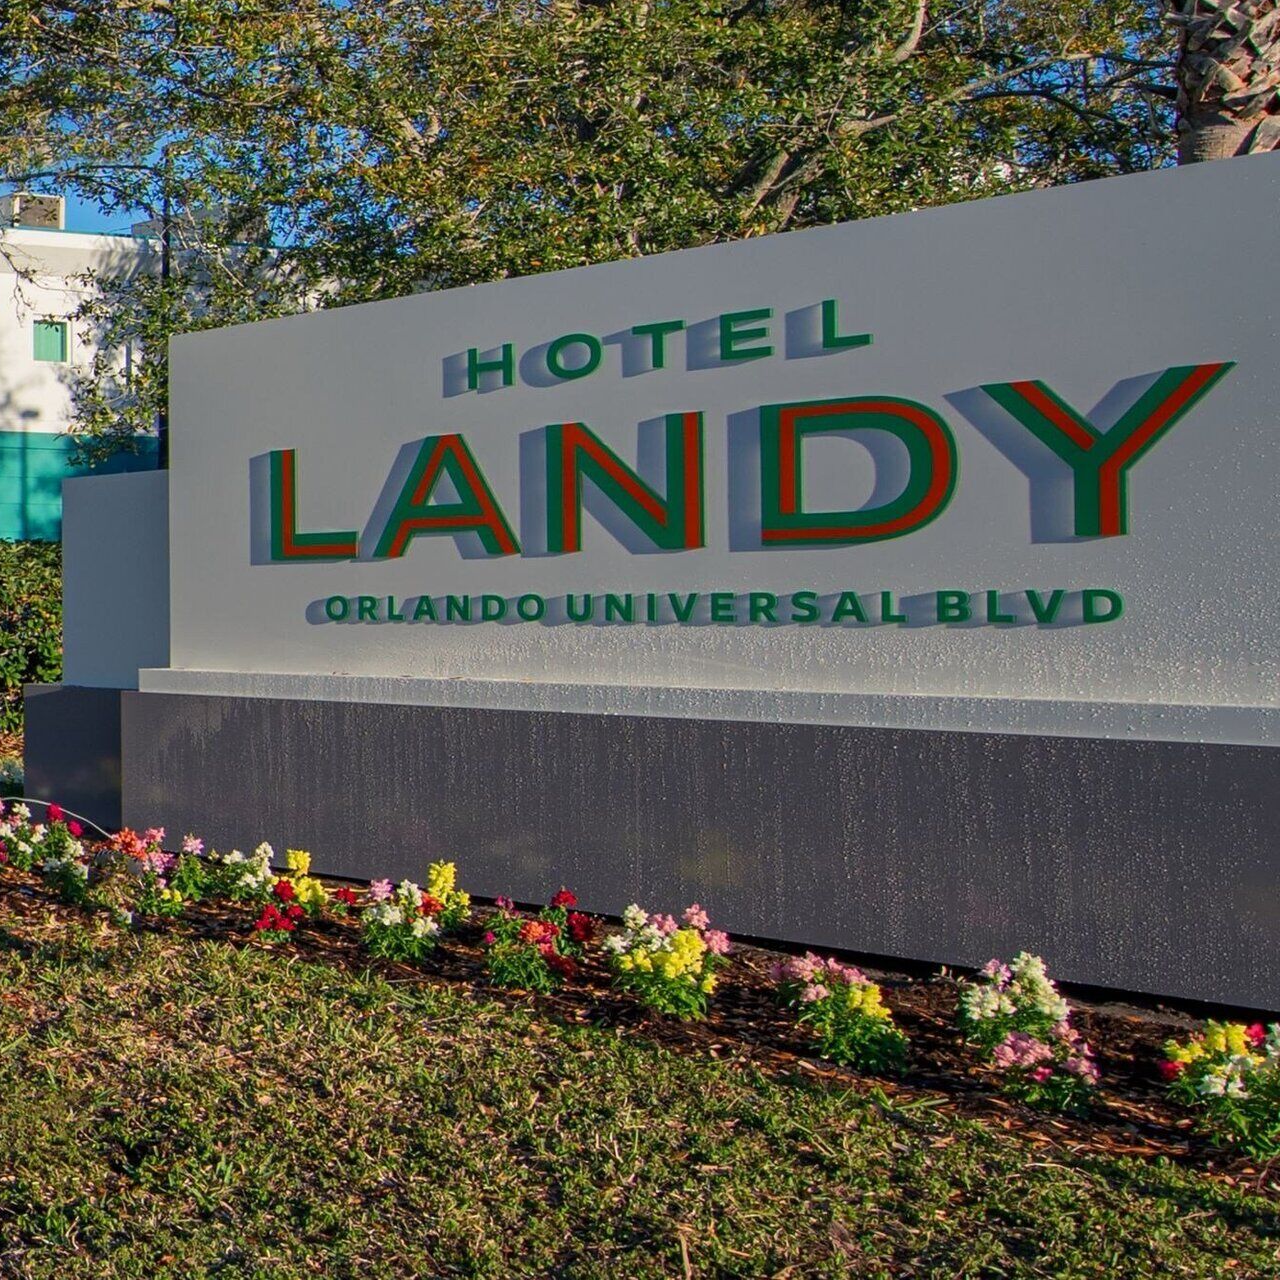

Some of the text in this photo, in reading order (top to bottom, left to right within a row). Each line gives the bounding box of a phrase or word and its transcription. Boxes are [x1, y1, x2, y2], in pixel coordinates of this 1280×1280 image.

[466, 298, 874, 391] HOTEL
[270, 361, 1235, 562] LANDY
[324, 588, 1126, 626] ORLANDO UNIVERSAL BLVD
